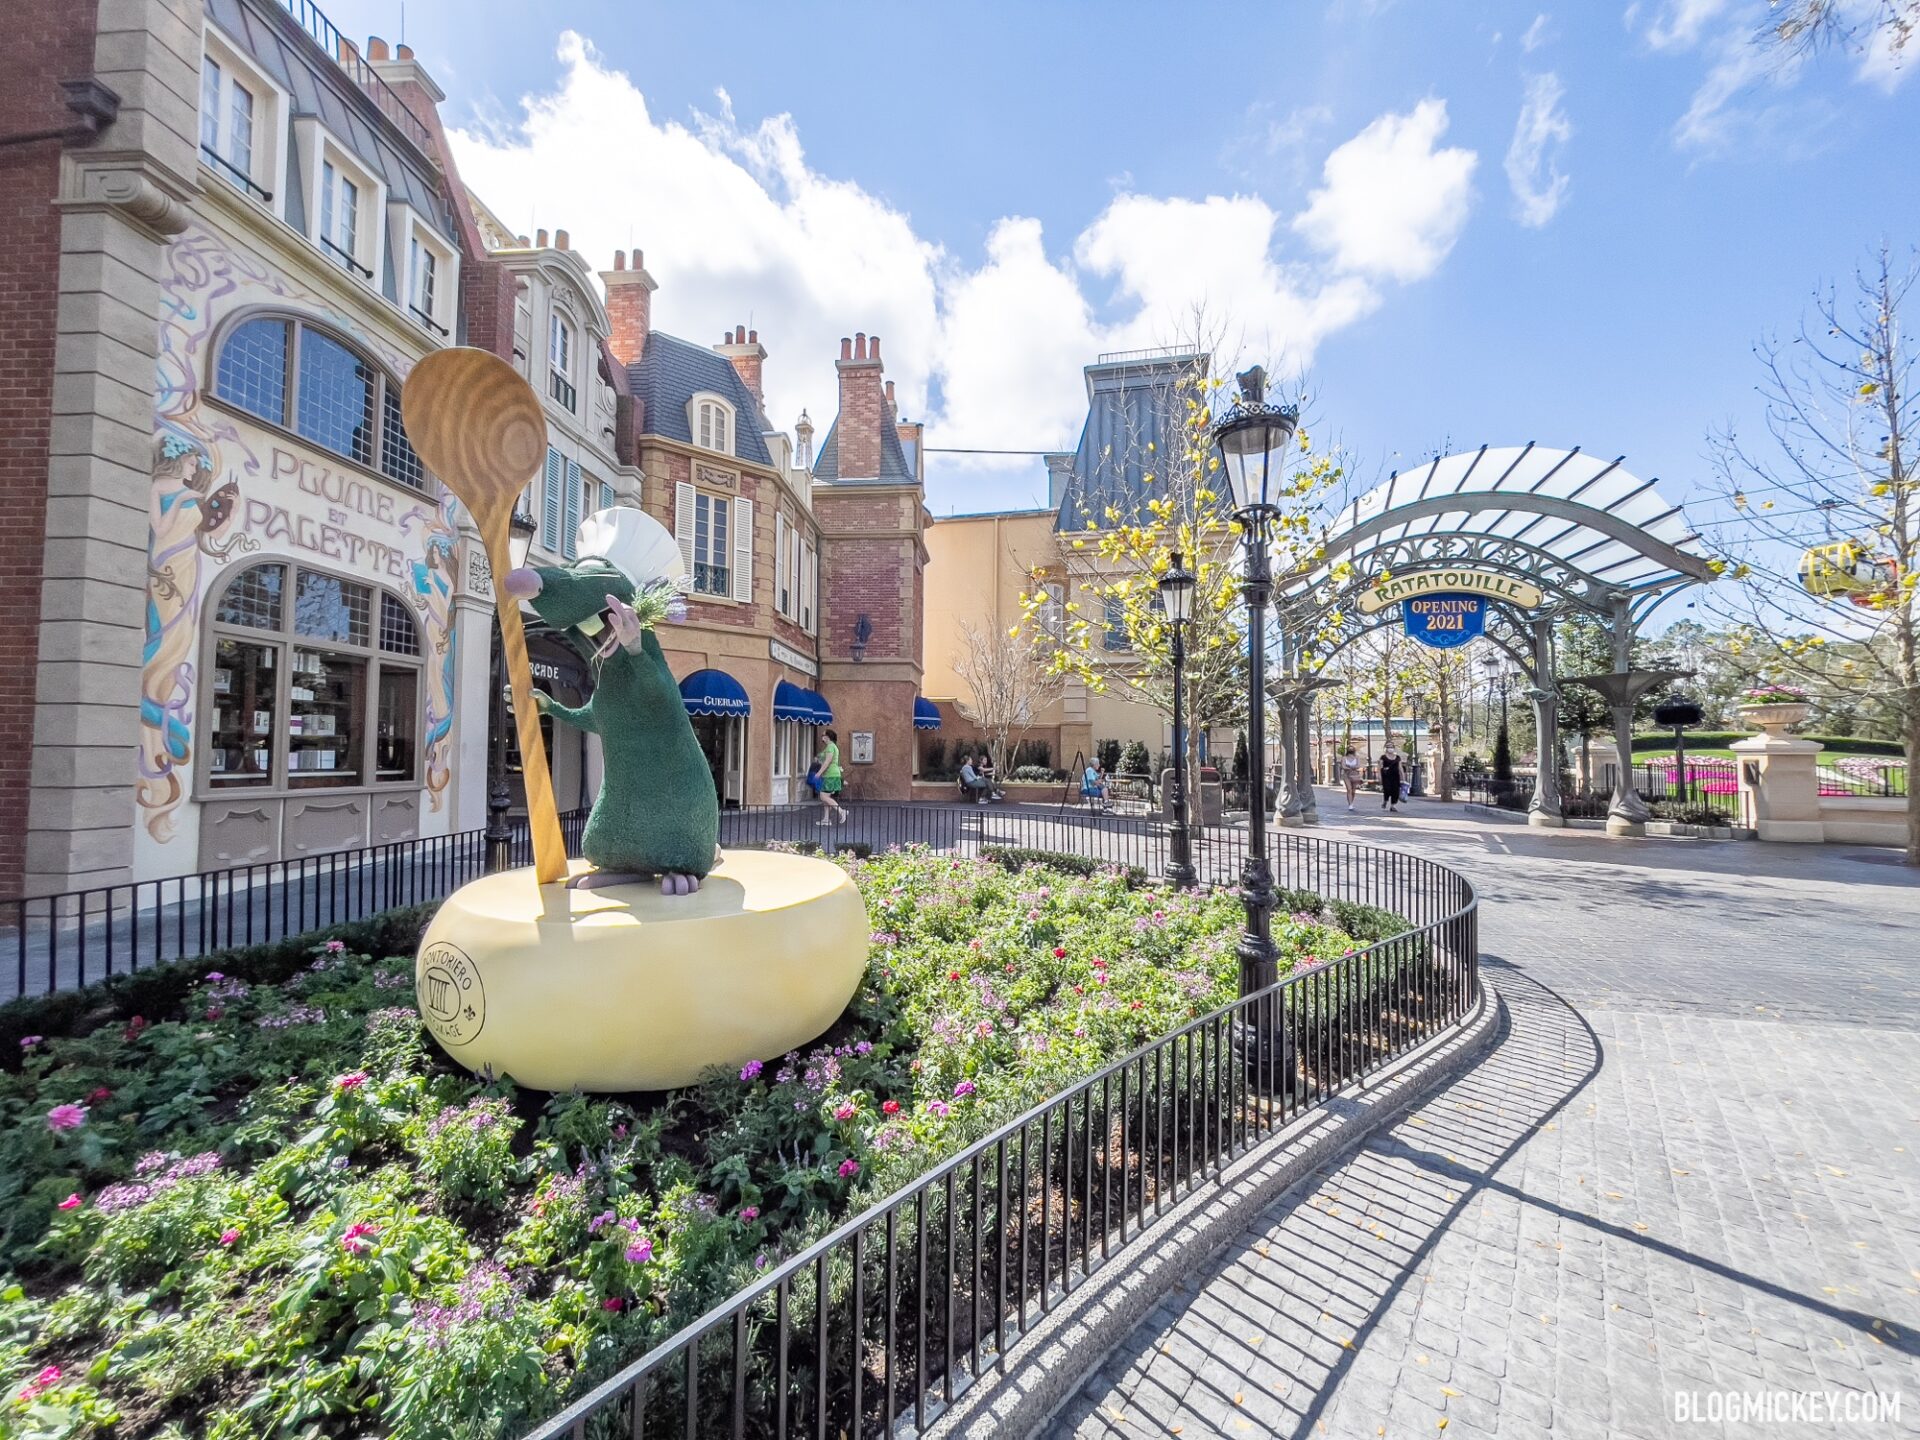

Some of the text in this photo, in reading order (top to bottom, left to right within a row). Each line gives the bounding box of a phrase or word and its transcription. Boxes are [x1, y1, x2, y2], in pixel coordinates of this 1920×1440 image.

[272, 447, 394, 525] PLUME
[329, 507, 348, 525] ET
[244, 498, 404, 578] PALETTE
[1375, 572, 1523, 602] RATATOUILLE
[1411, 600, 1479, 613] OPENING
[1426, 614, 1464, 630] 2021
[529, 662, 559, 679] RCADE
[704, 696, 744, 707] GUERLAIN
